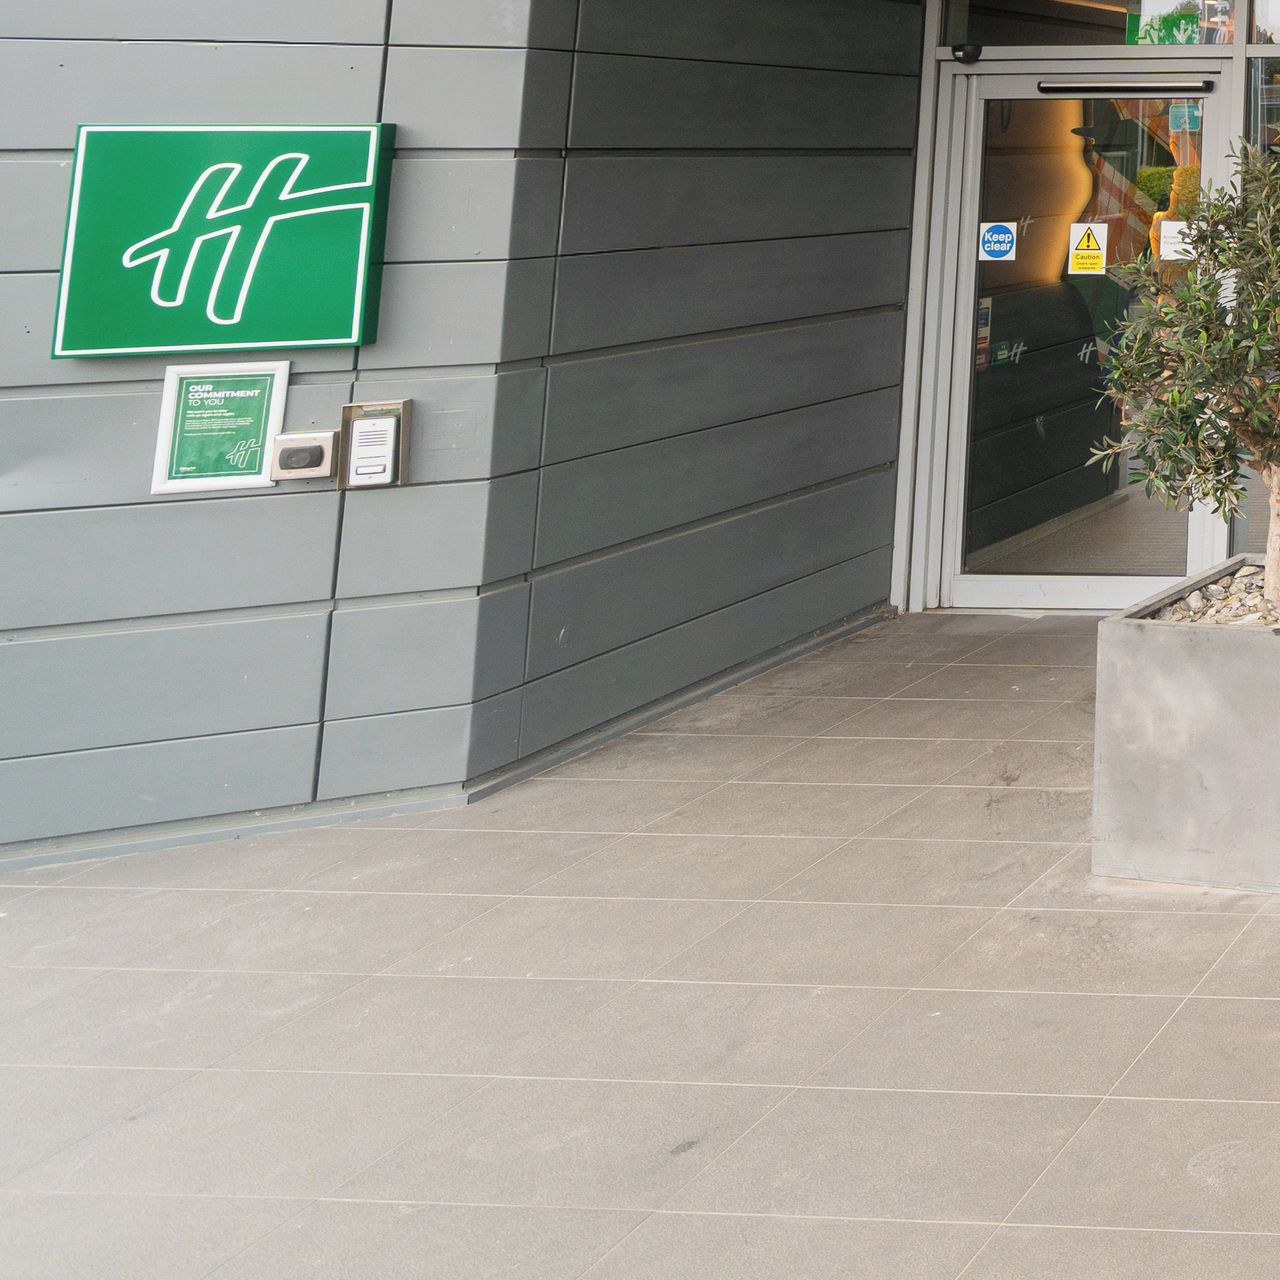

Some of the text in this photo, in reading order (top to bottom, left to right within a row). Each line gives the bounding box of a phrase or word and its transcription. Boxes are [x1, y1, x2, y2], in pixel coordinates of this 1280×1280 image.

[984, 232, 1012, 243] Keep
[984, 242, 1012, 251] clear
[188, 390, 261, 399] COMMITMENT
